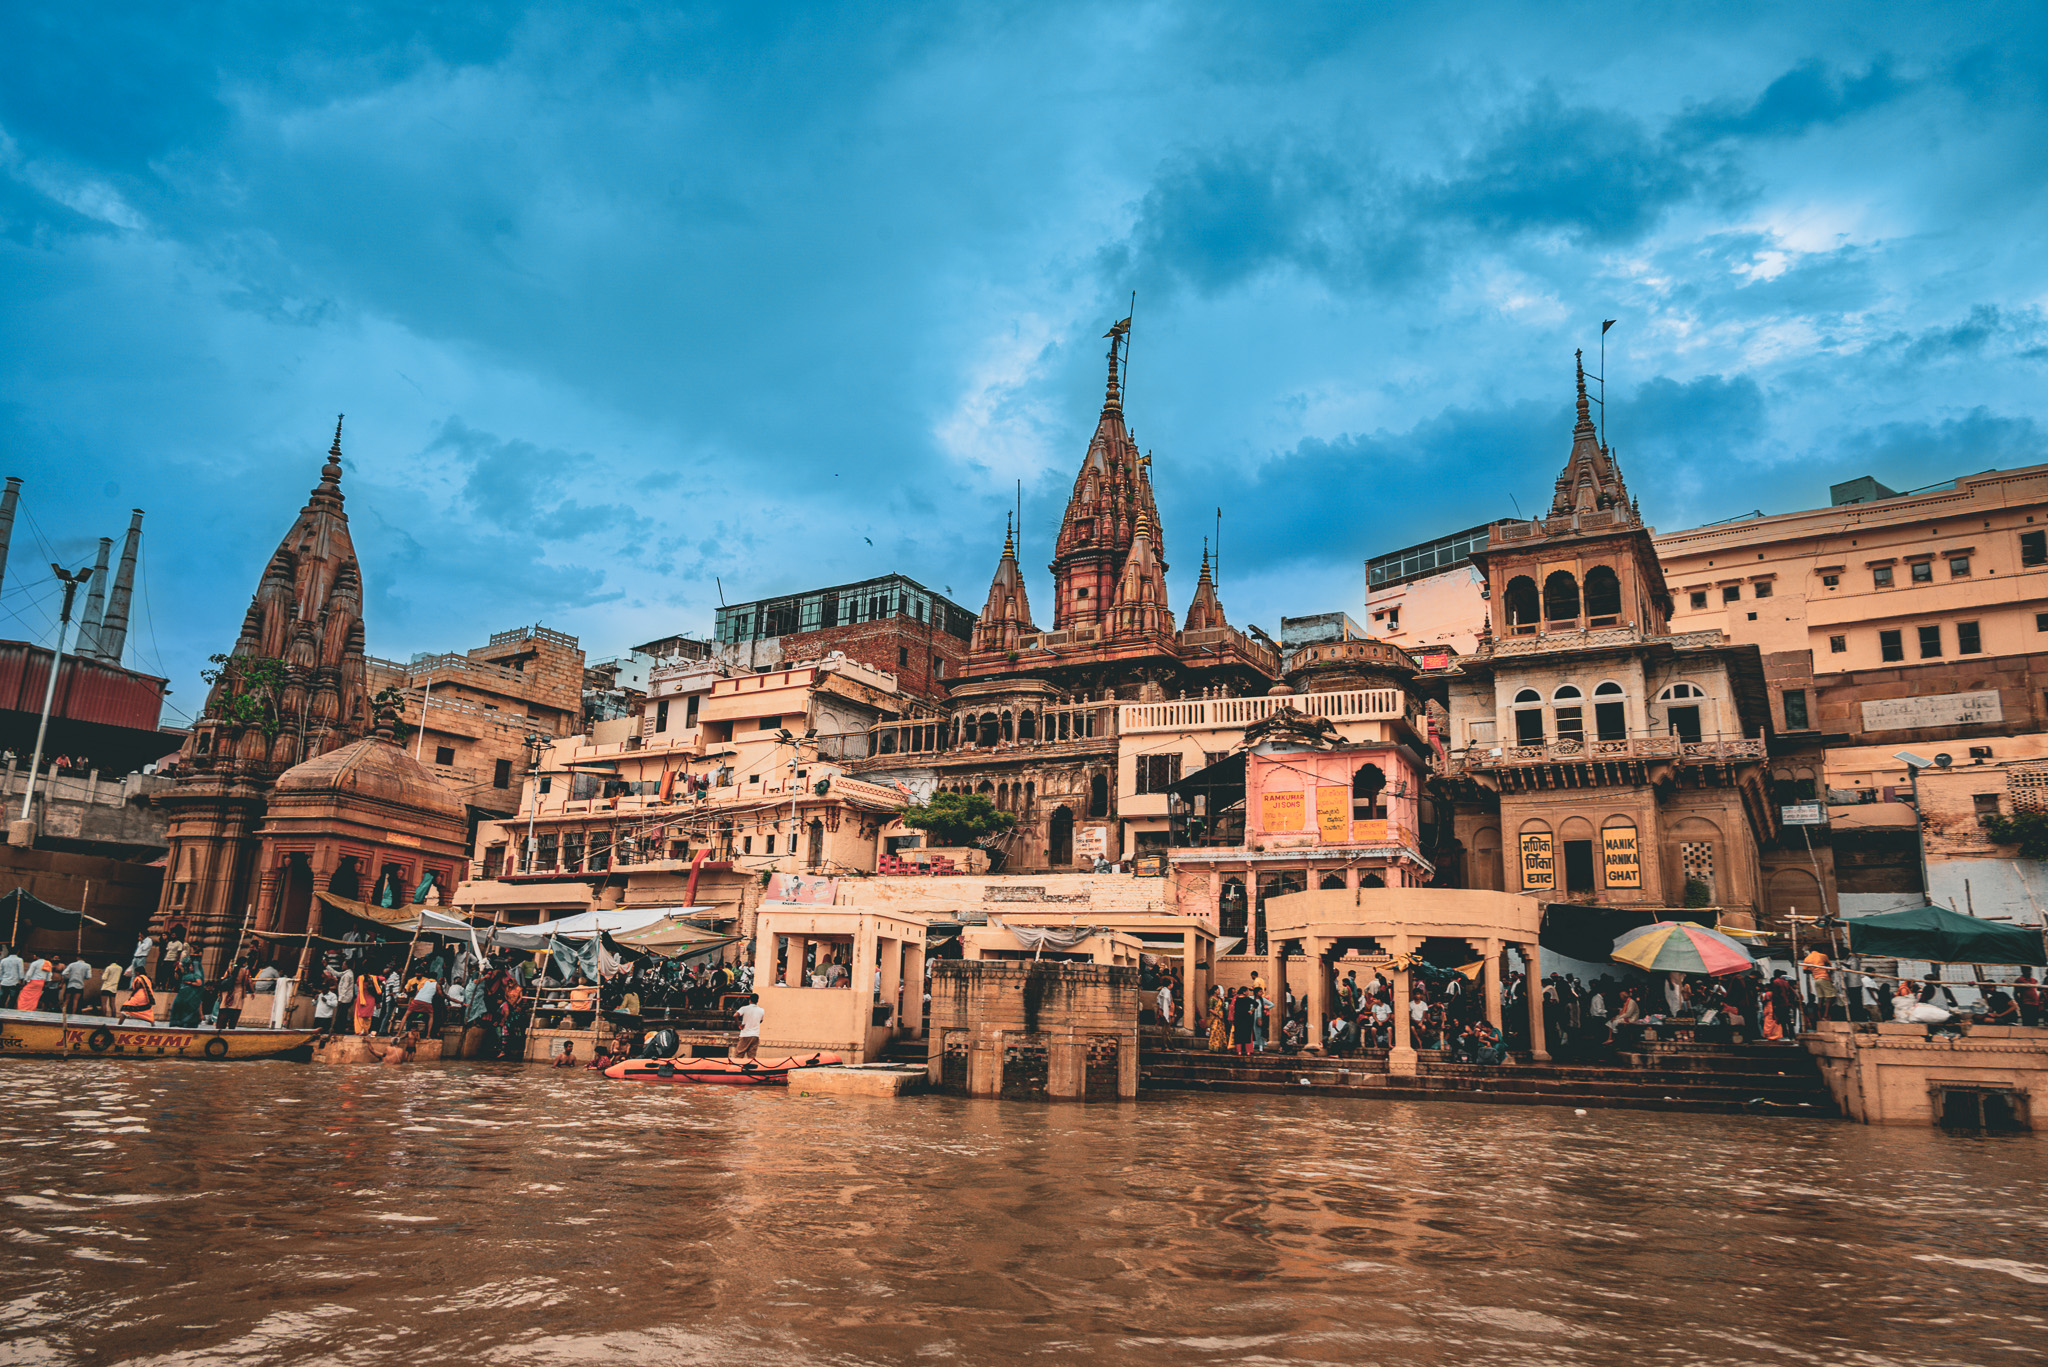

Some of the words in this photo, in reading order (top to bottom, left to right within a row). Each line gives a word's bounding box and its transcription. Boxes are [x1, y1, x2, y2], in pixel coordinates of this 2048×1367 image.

[1264, 794, 1304, 802] RAMKUMAR
[1523, 836, 1551, 852] मणिक
[1605, 838, 1635, 850] MANIK
[1605, 853, 1639, 865] ARNIKA
[1527, 873, 1552, 884] घाट
[1608, 870, 1638, 881] GHAT
[56, 1030, 86, 1047] JK
[73, 1042, 187, 1055] CMENT
